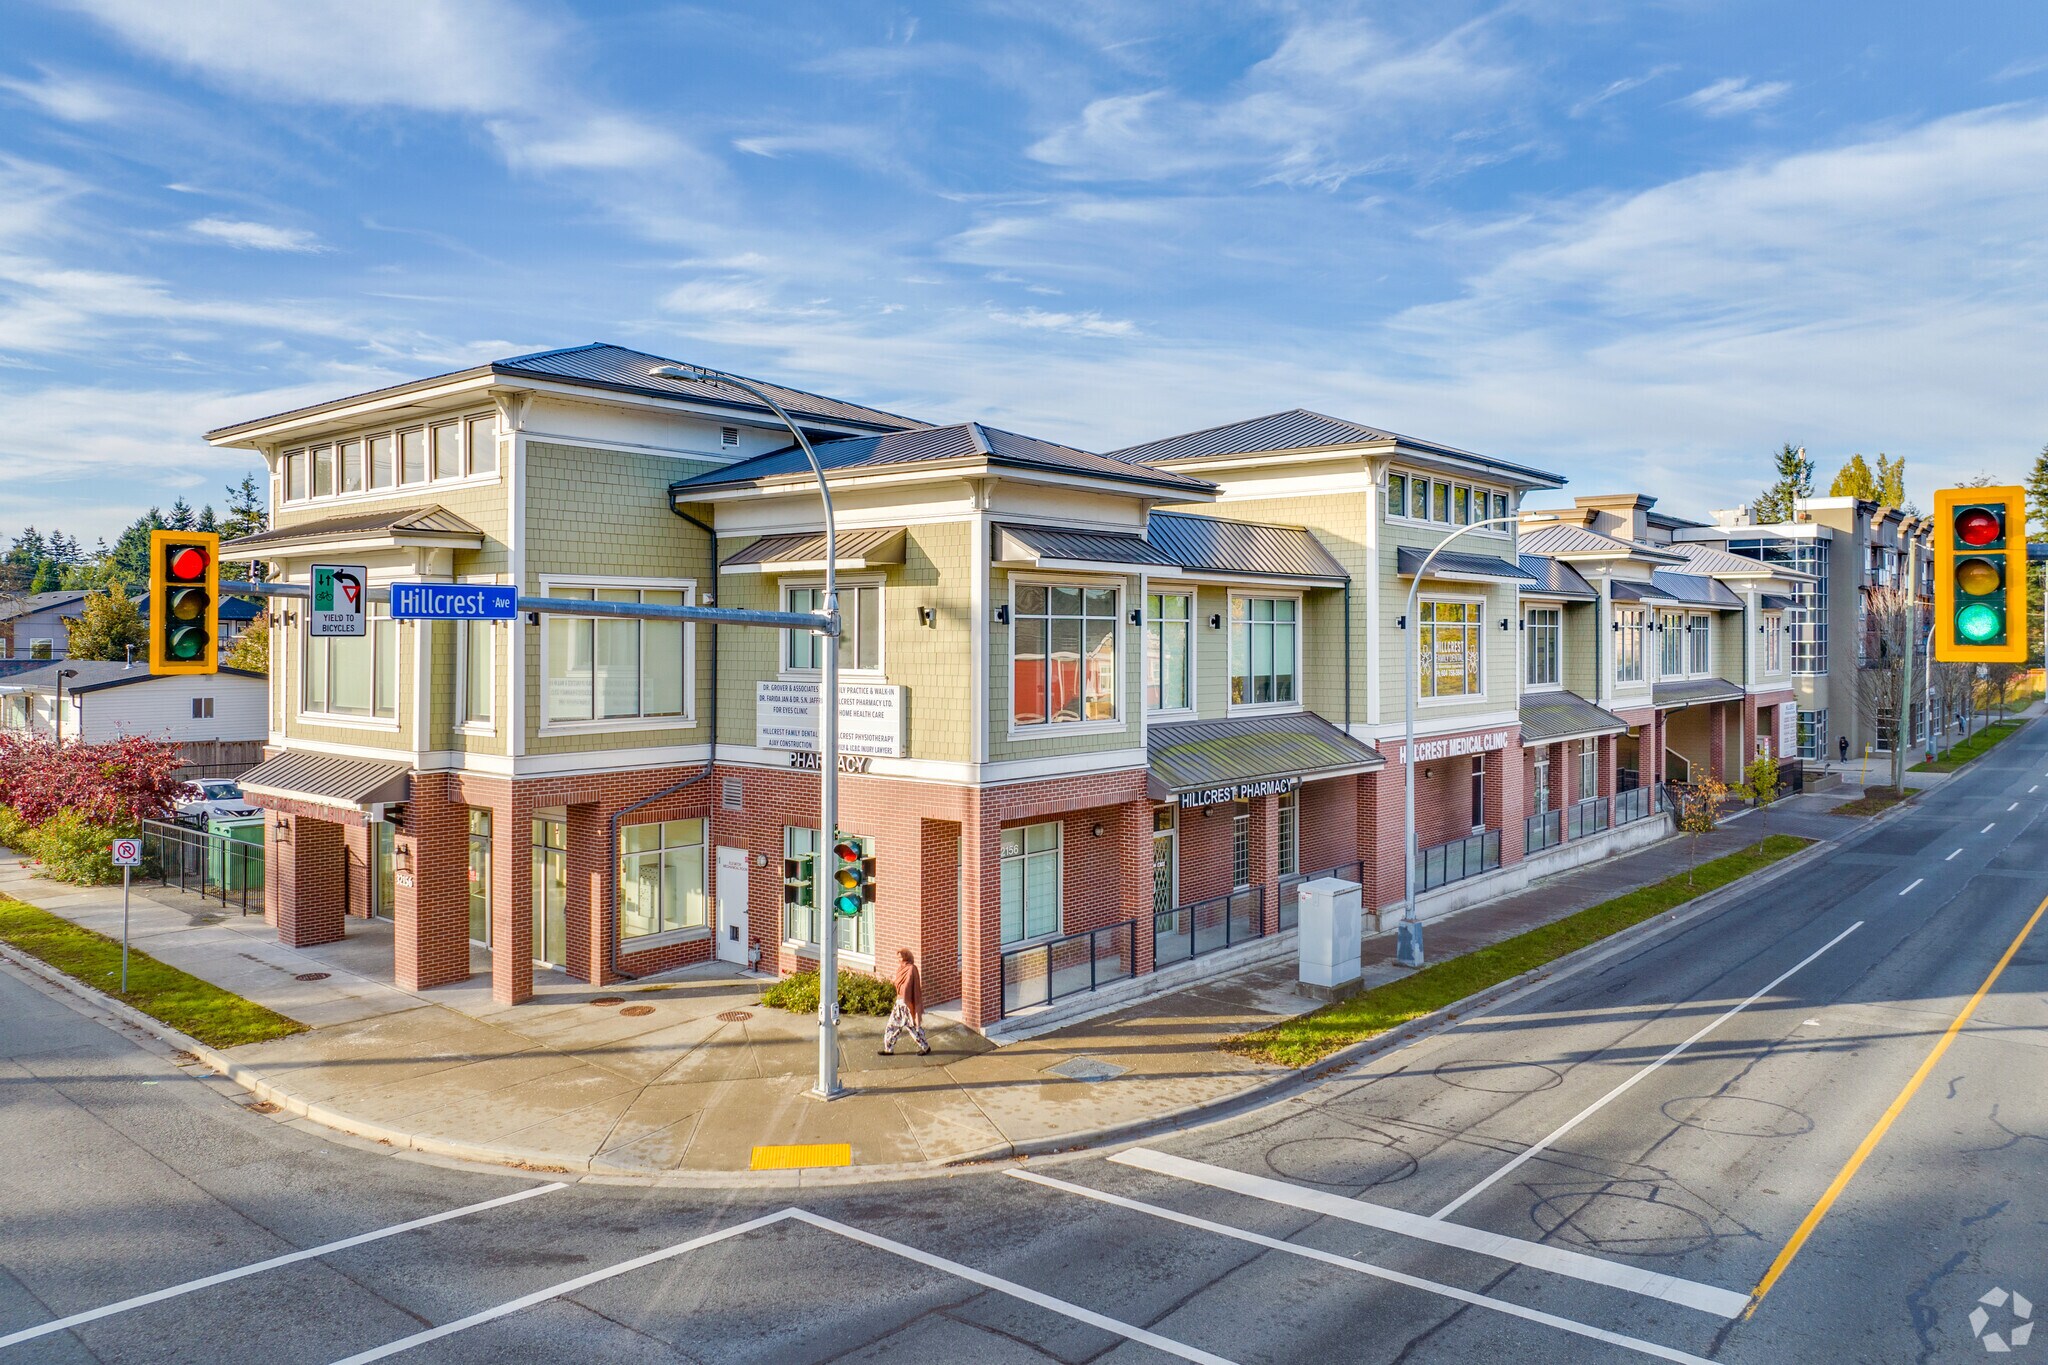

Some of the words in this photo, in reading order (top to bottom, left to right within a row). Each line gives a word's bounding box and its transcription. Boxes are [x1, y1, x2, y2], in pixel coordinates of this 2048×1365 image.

[400, 588, 485, 615] Hillcrest
[495, 597, 510, 608] Ave
[323, 614, 344, 622] YIELD
[346, 614, 355, 622] TO
[322, 624, 355, 632] BICYCLES
[793, 685, 819, 693] ASSOCIATES
[847, 687, 869, 695] PRACTICE
[875, 688, 895, 696] WALK-IN
[856, 699, 882, 707] PHARMACY
[882, 700, 893, 708] LTD.
[794, 707, 808, 715] CLINIC
[839, 709, 852, 717] HOME
[853, 710, 871, 718] HEALTH
[872, 711, 884, 719] CARE
[762, 728, 785, 736] HILLCREST
[785, 728, 800, 737] FAMILY
[801, 729, 819, 738] DENTAL
[855, 733, 894, 743] PHYSIOTHERAPY
[780, 740, 812, 749] CONSTRUCTION
[1400, 742, 1448, 764] HLCREST
[1449, 736, 1483, 756] MEDICAL
[1483, 731, 1508, 751] CLINIC
[875, 746, 893, 755] LAWYERS
[790, 752, 865, 773] PHARACY
[1182, 787, 1237, 808] HILLCREST
[1241, 778, 1293, 799] PHARMACY
[1000, 844, 1019, 857] 2156
